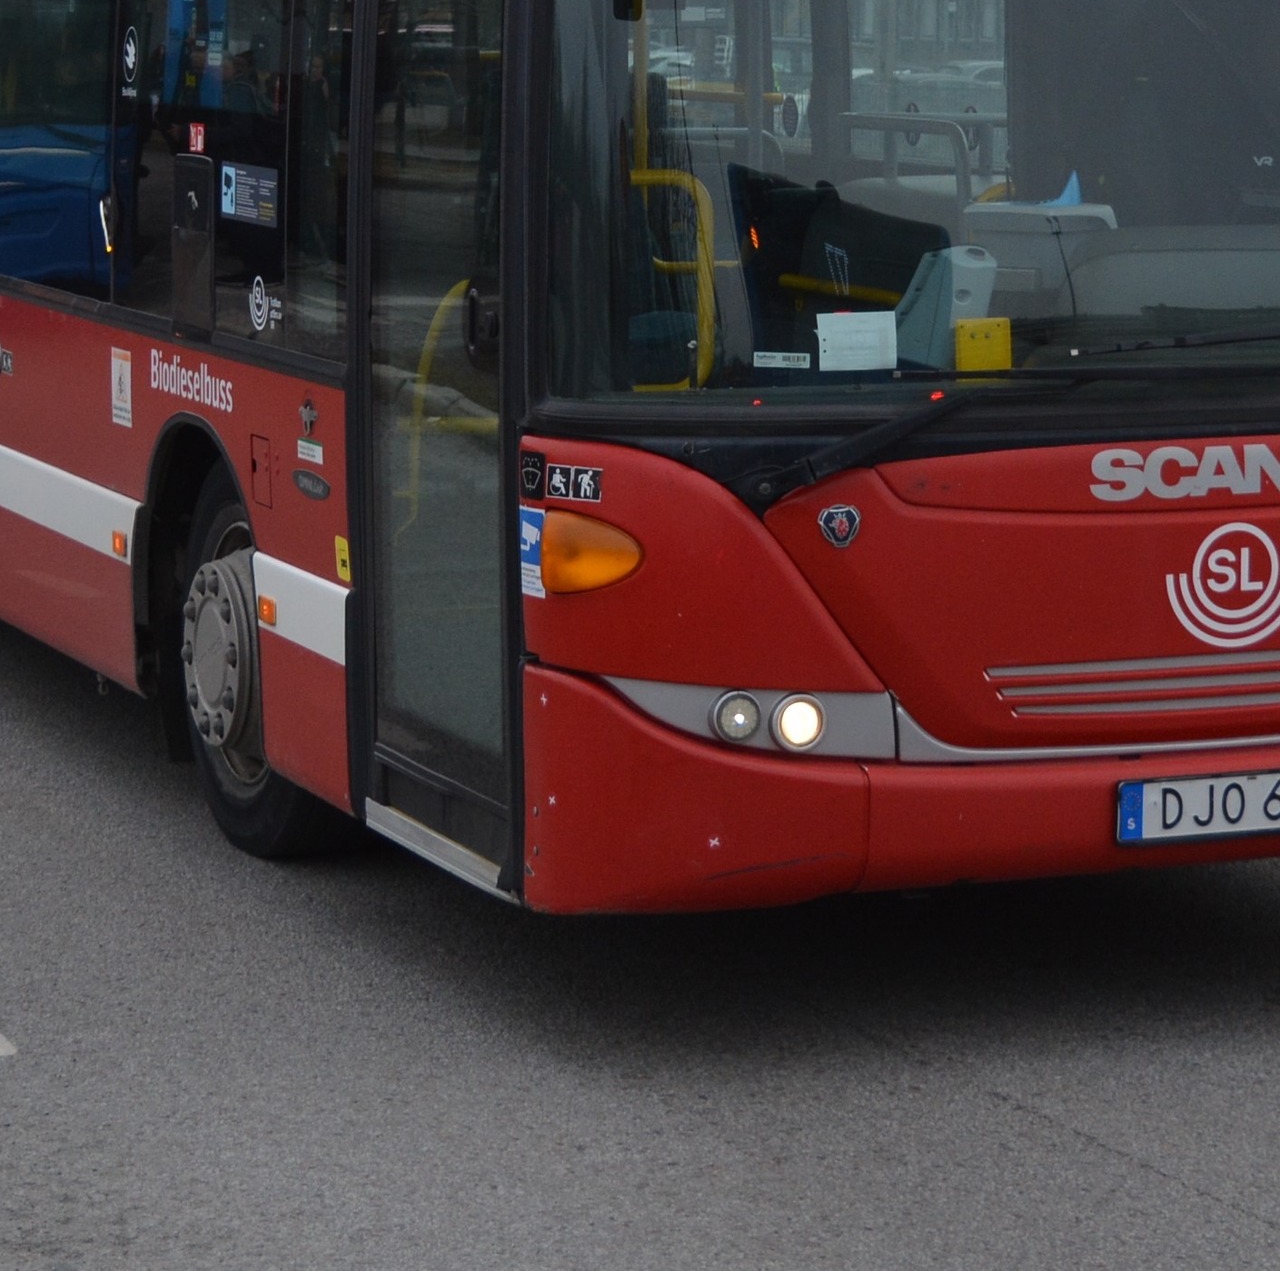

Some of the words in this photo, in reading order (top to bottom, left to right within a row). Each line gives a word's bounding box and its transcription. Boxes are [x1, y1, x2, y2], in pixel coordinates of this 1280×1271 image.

[150, 348, 233, 413] Biodieselbuss
[1206, 547, 1264, 593] SL
[1126, 817, 1137, 831] S
[1161, 782, 1246, 830] DJO
